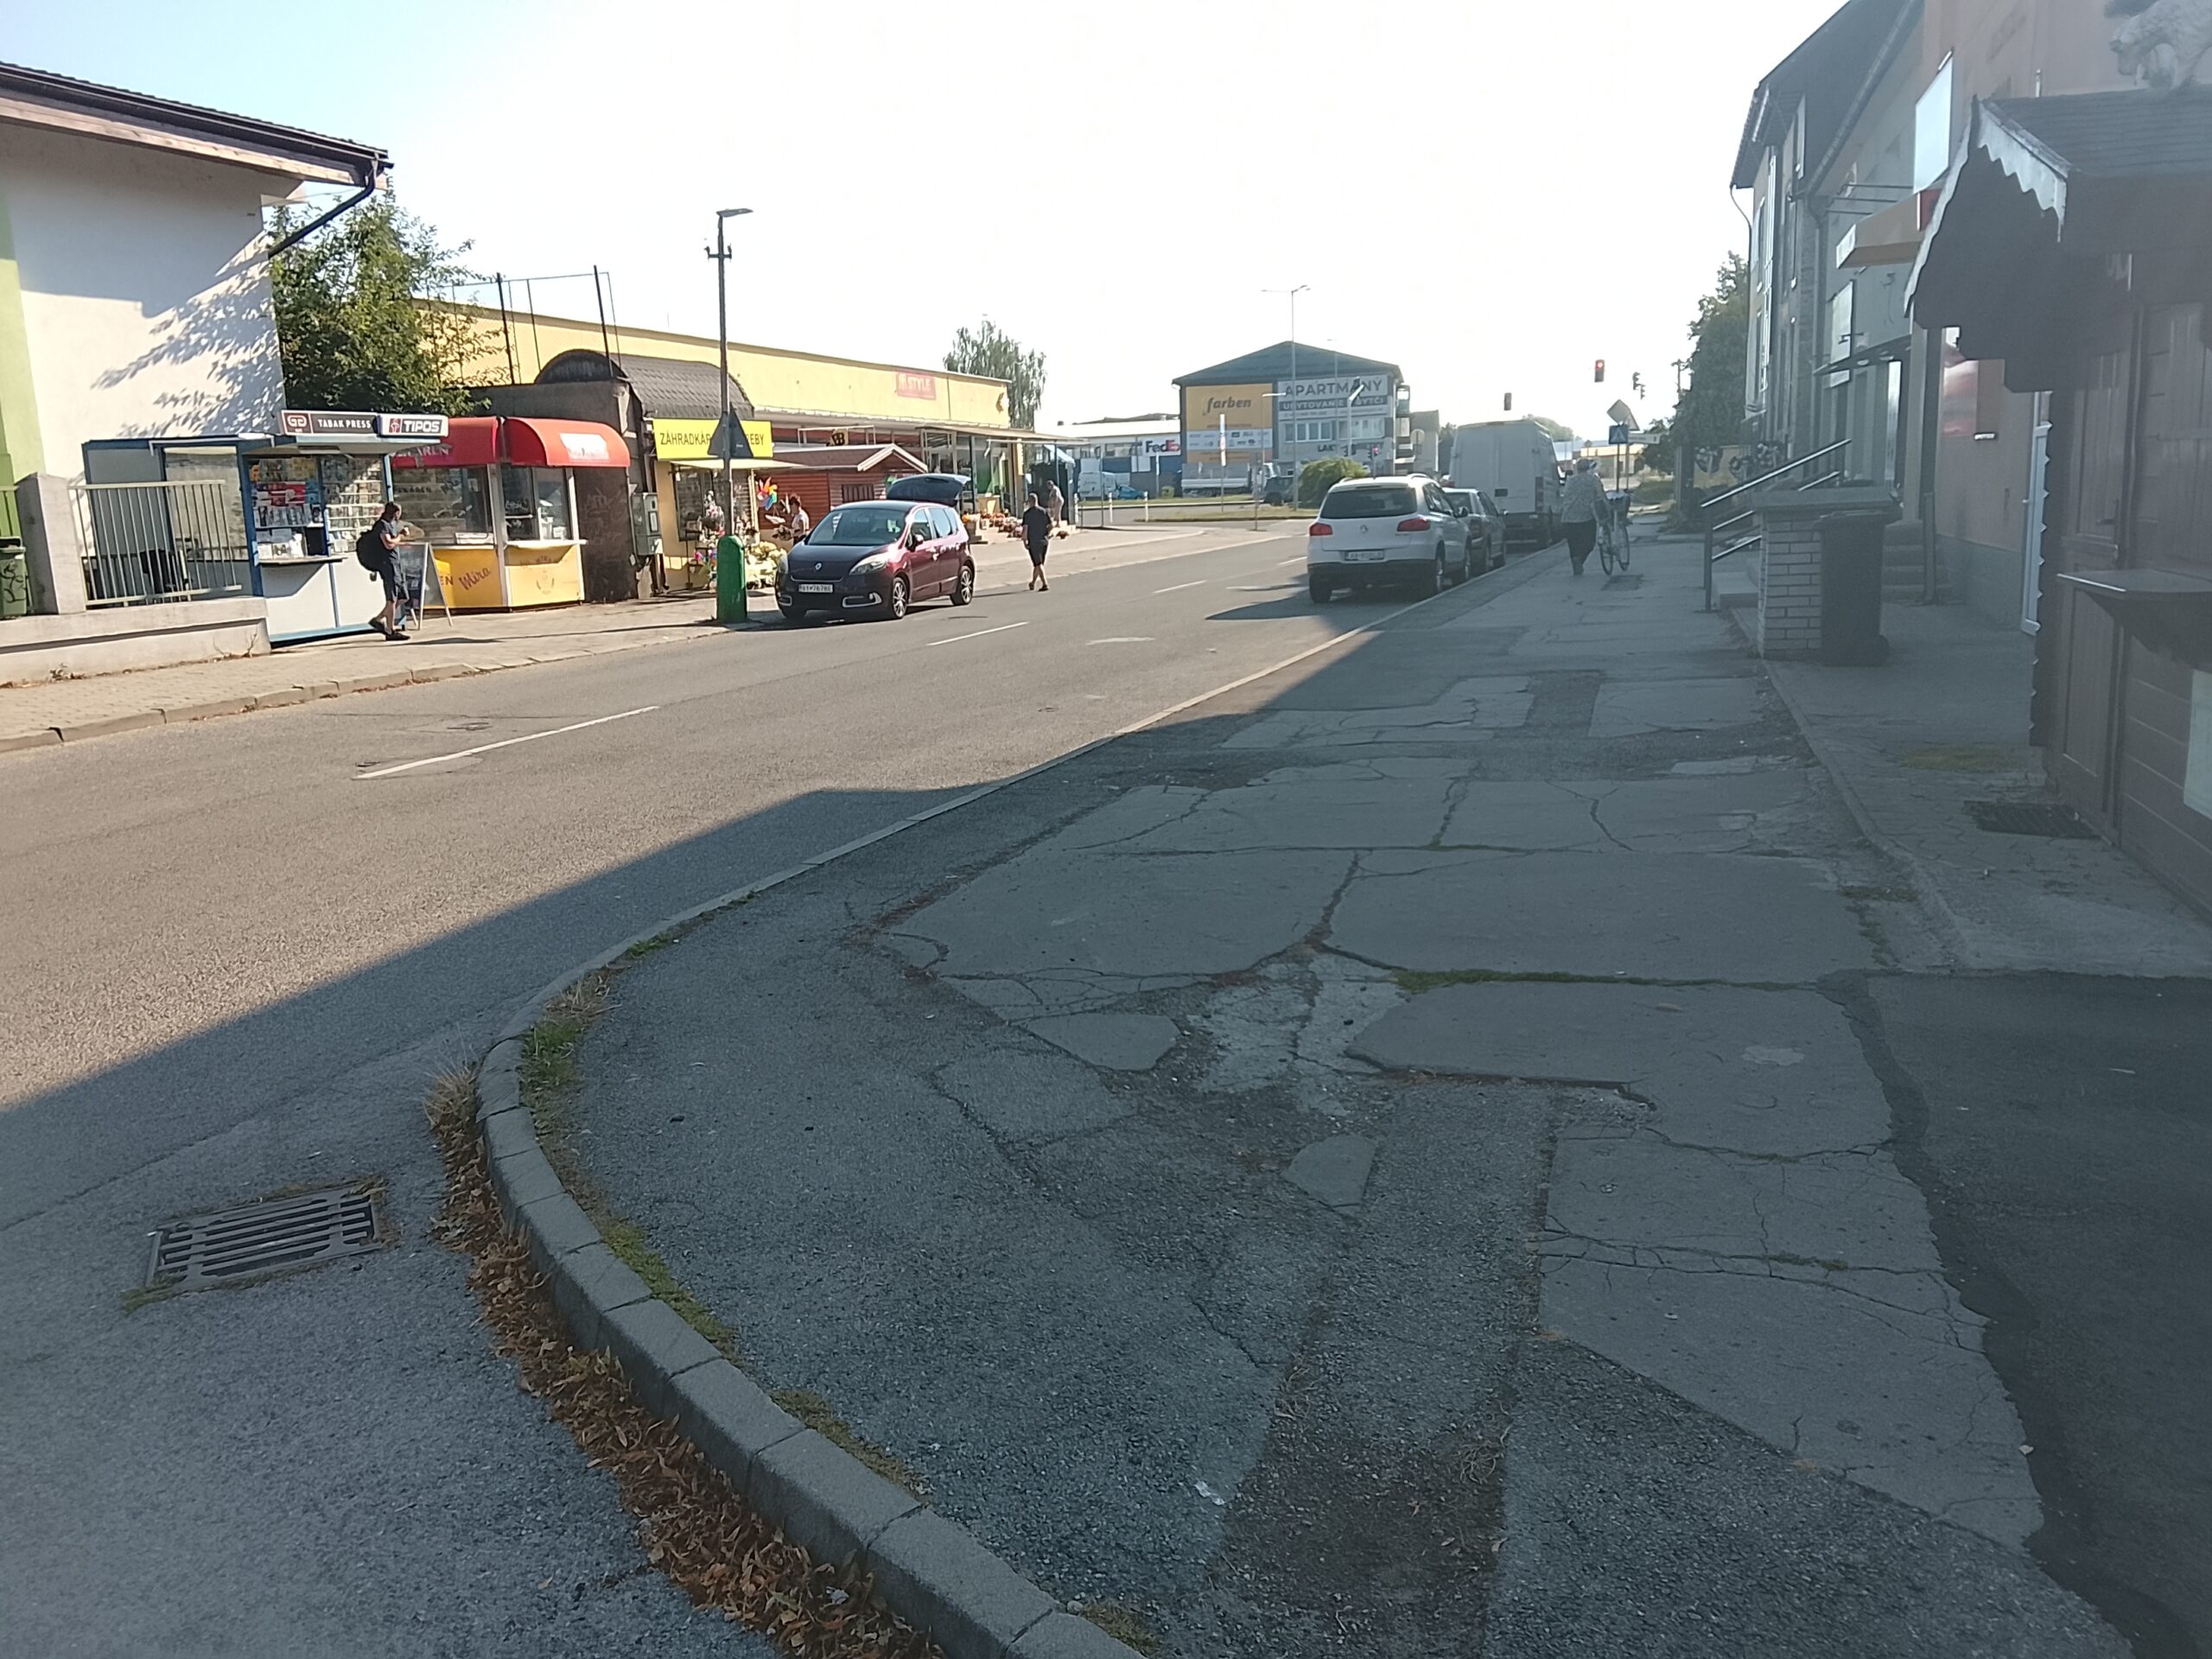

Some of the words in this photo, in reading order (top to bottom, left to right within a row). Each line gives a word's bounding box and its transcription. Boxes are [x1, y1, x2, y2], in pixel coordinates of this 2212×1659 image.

[1206, 397, 1252, 414] farben
[1283, 399, 1345, 410] UYTOVANE
[317, 418, 344, 429] TABAK
[346, 419, 372, 429] PRESS
[403, 420, 441, 433] TIPOS
[660, 429, 711, 446] ZÁHRADKÁR
[458, 567, 492, 590] Mira
